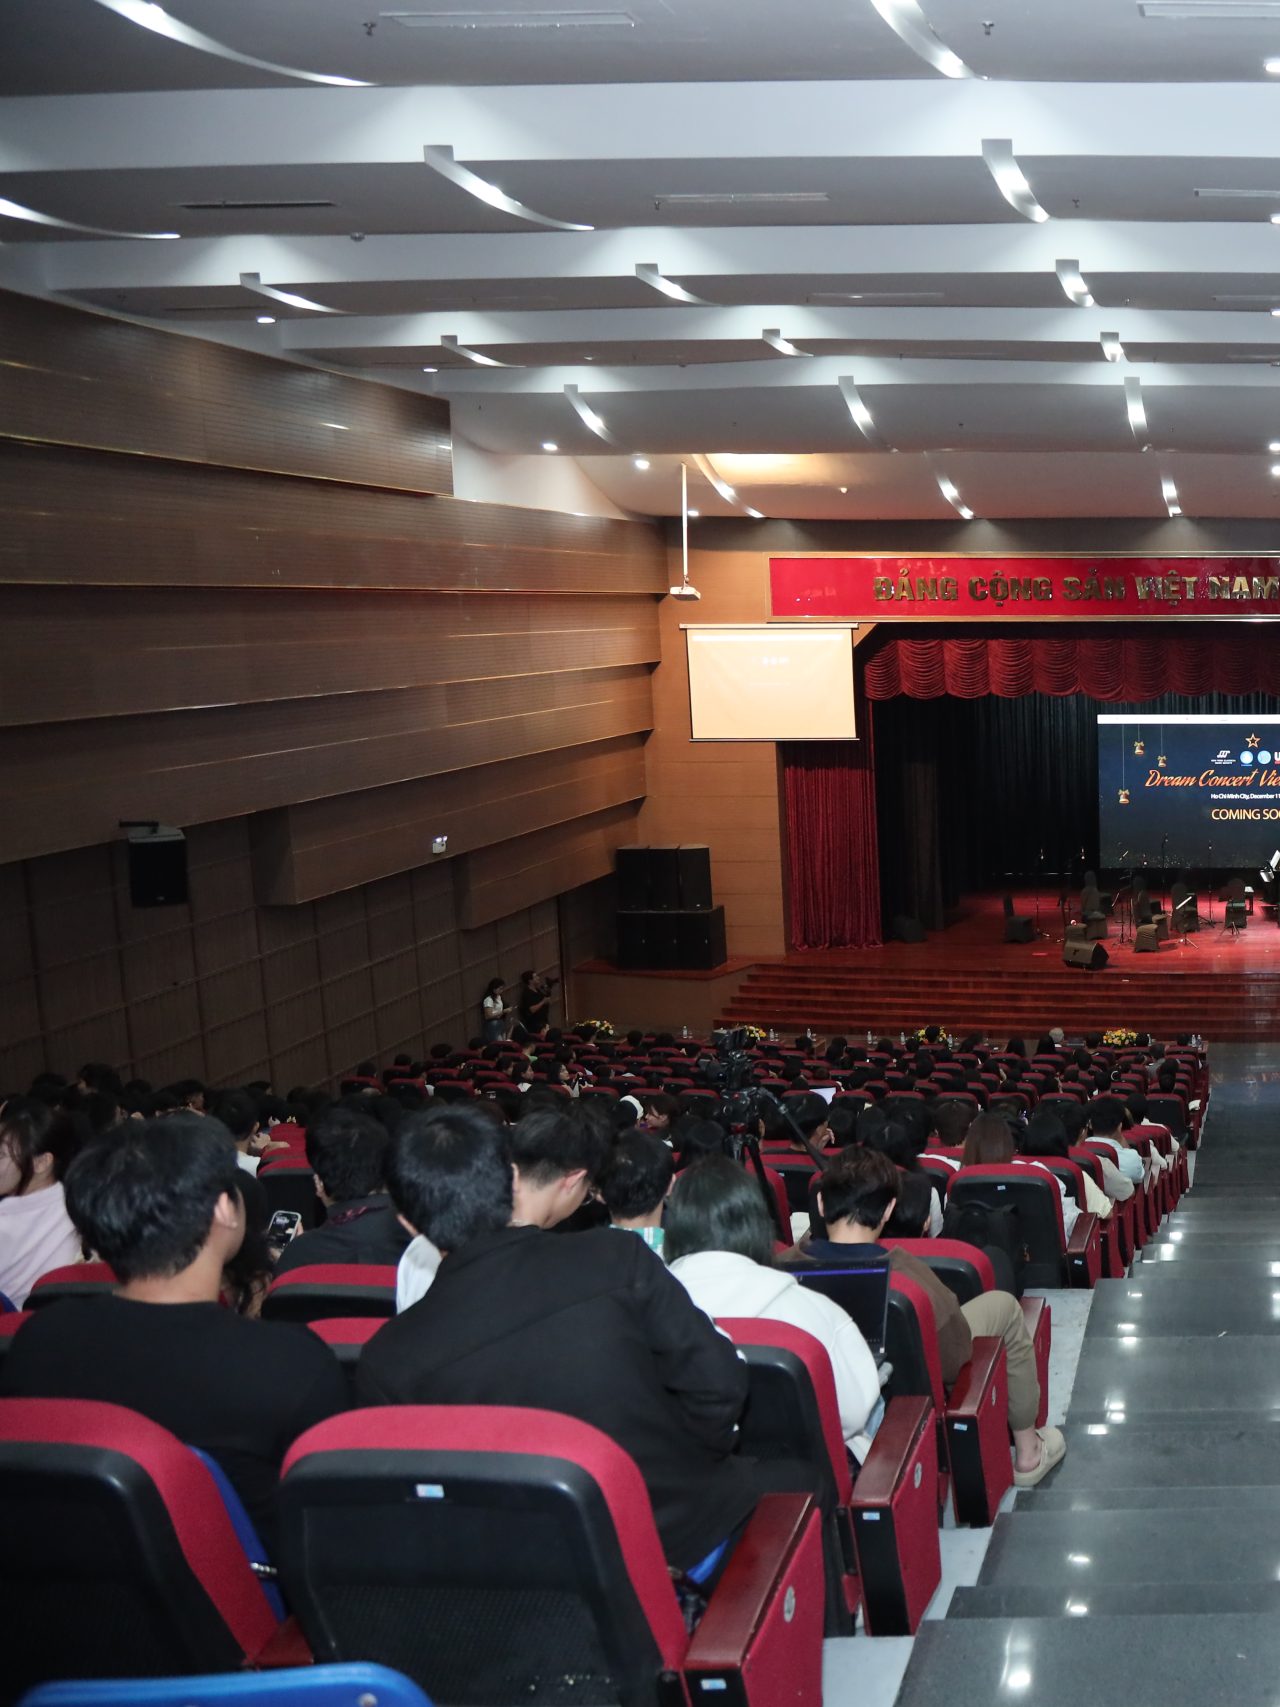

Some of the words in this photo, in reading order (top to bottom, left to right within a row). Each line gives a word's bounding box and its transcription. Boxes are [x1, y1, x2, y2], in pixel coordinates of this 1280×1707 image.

[873, 568, 958, 601] ĐẢNG
[968, 570, 1052, 607] CỘNG
[1062, 567, 1125, 601] SẢN
[1135, 569, 1199, 606] VIỆT
[1208, 576, 1279, 600] NAM
[1144, 769, 1197, 787] Dream
[1198, 768, 1259, 787] Concert
[1211, 808, 1261, 820] COMING
